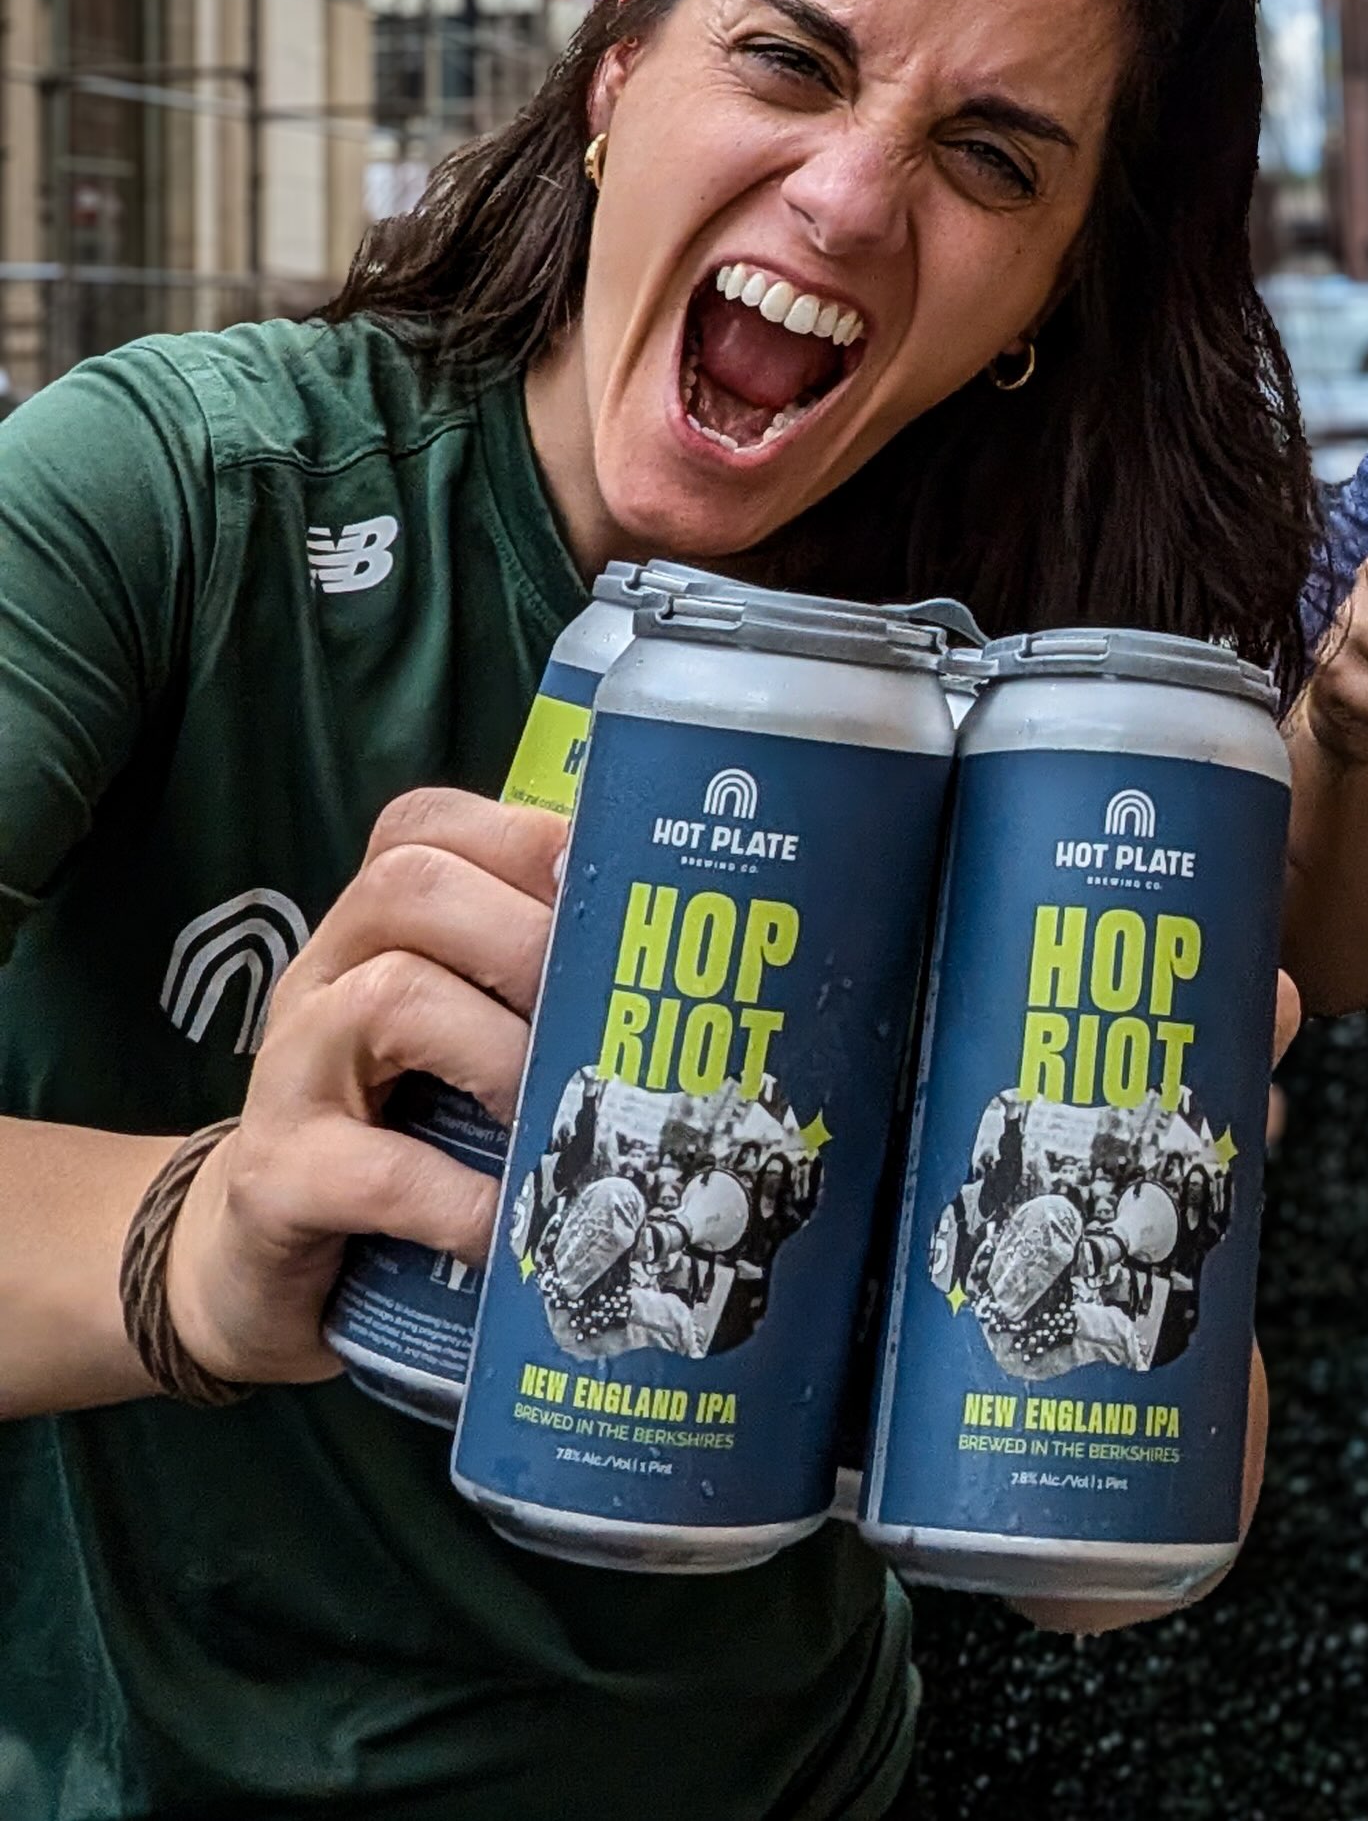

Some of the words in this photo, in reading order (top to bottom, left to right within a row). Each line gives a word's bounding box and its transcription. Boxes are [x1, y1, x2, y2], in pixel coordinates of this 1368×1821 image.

[652, 817, 706, 849] HOT
[710, 826, 800, 861] PLATE
[1055, 841, 1109, 869] HOT
[1115, 845, 1196, 878] PLATE
[614, 881, 799, 1004] HOP
[1027, 905, 1202, 1016] HOP
[598, 989, 785, 1101] RIOT
[1019, 1011, 1195, 1112] RIOT
[520, 1363, 569, 1403] NEW
[573, 1376, 688, 1422] ENGLAND
[695, 1391, 737, 1424] IPA
[964, 1393, 1017, 1428] NEW
[1025, 1397, 1137, 1436] ENGLAND
[1145, 1405, 1180, 1438] IPA
[514, 1402, 574, 1430] BREWED
[575, 1418, 594, 1435] IN
[597, 1420, 630, 1441] THE
[632, 1427, 735, 1450] BERKSHIRES
[958, 1434, 1027, 1454] BREWED
[1030, 1440, 1049, 1456] IN
[1052, 1441, 1085, 1458] THE
[1088, 1443, 1181, 1464] BERKSHIRES
